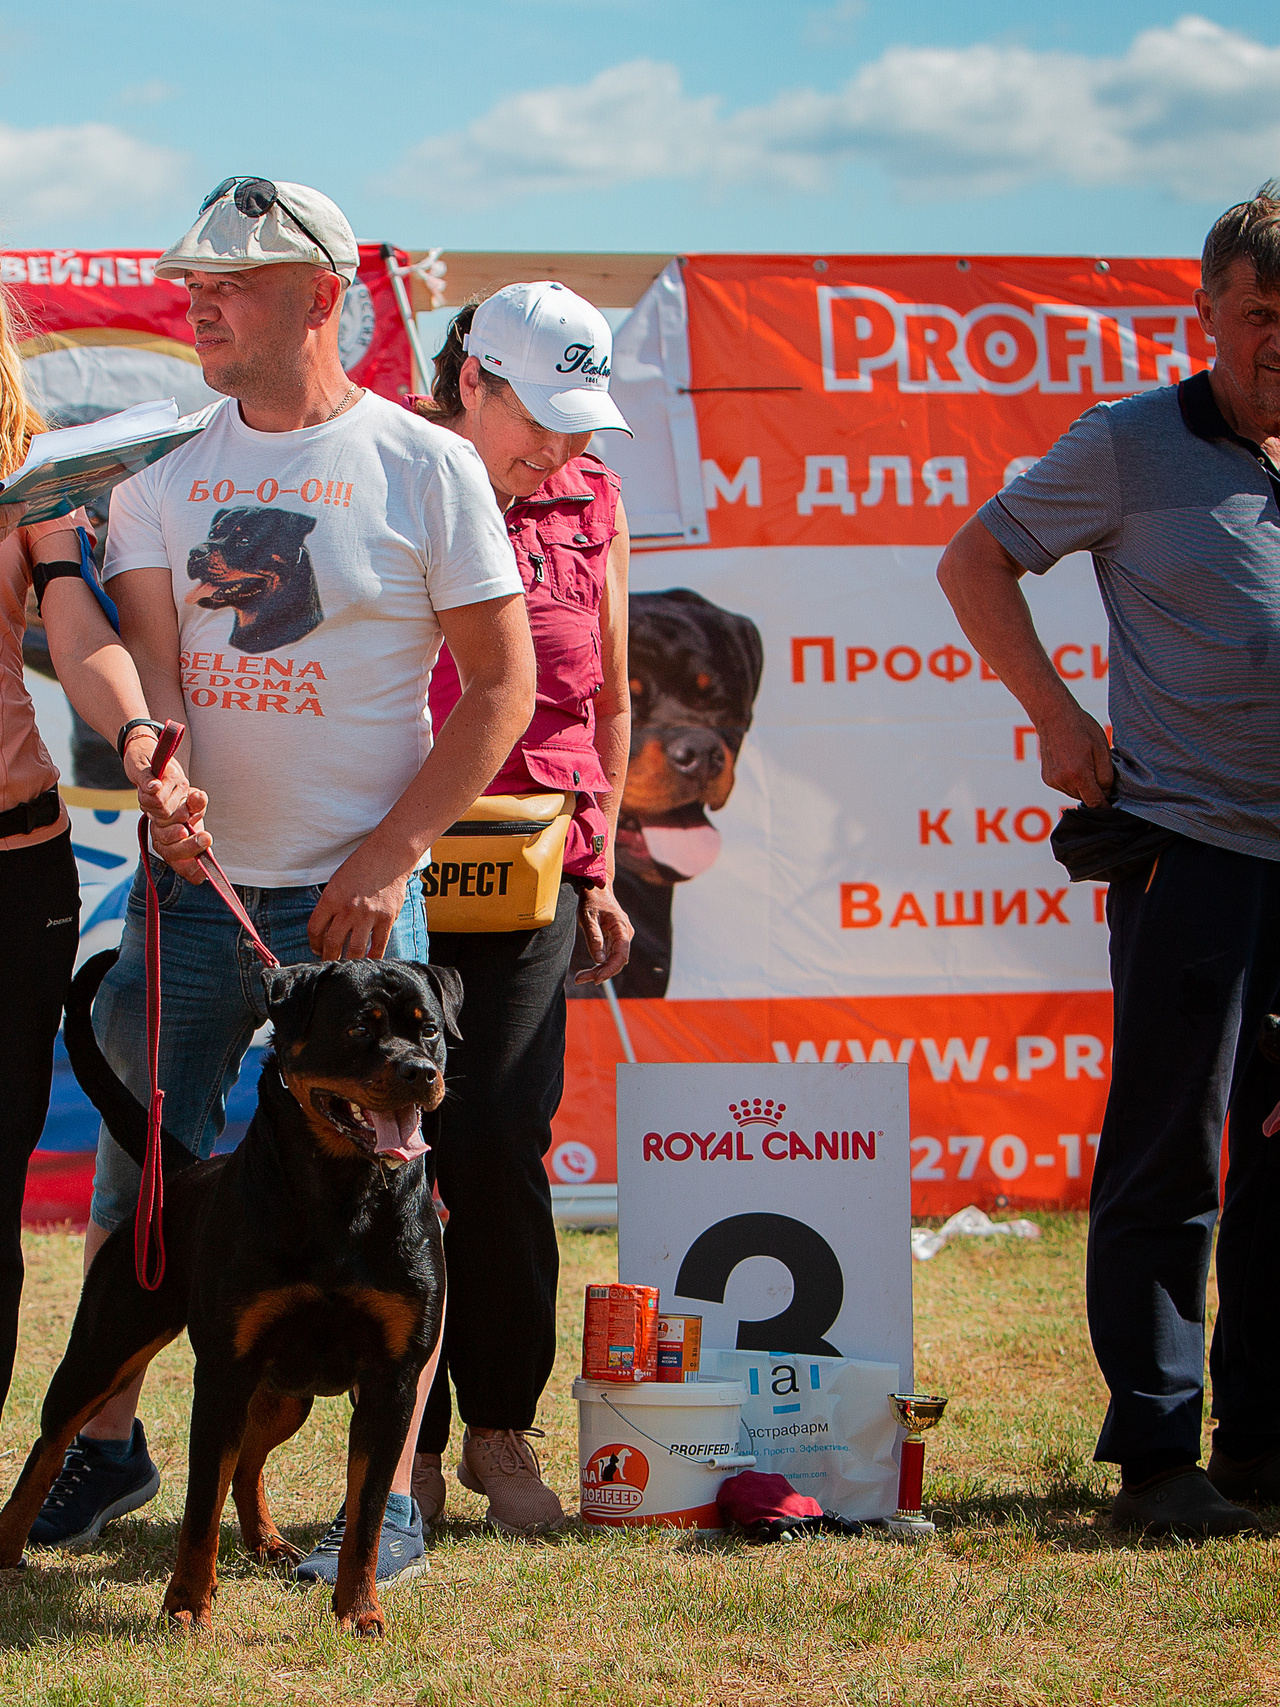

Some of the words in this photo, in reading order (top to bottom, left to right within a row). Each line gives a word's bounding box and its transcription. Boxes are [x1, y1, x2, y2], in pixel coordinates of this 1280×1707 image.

[179, 651, 328, 681] SELENA
[208, 674, 319, 695] DOMA
[975, 805, 1078, 845] КО
[421, 861, 514, 898] SPECT
[643, 1131, 754, 1162] ROYAL
[762, 1131, 877, 1161] CANIN
[674, 1212, 844, 1358] 3
[749, 1422, 829, 1440] астрафарм
[763, 1446, 797, 1457] Просто.
